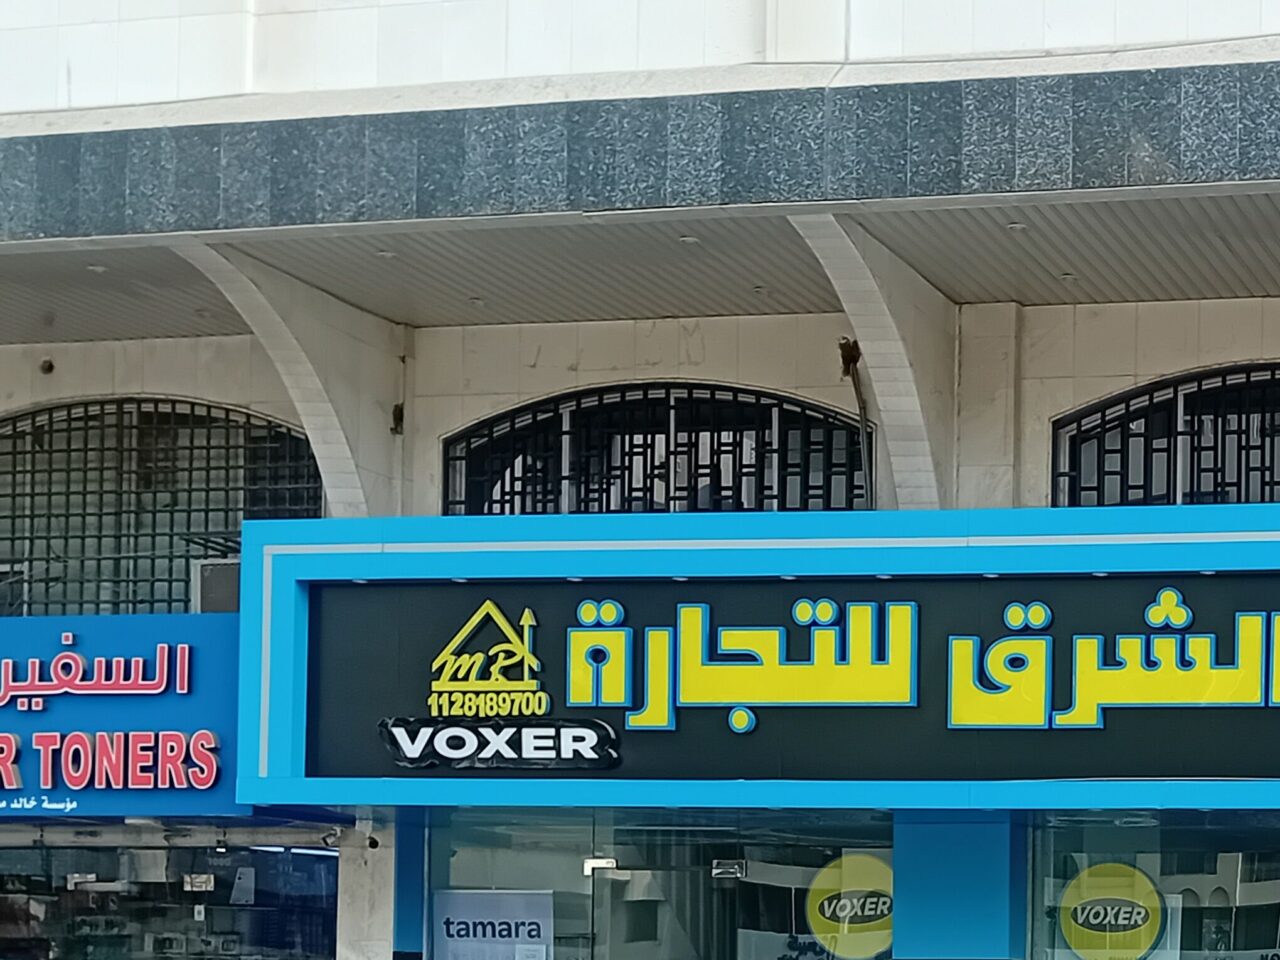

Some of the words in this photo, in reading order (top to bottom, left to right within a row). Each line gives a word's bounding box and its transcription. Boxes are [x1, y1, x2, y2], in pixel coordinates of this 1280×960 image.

[0, 632, 191, 711] السفير
[566, 598, 918, 734] للتجارة
[428, 691, 549, 717] 1128189700
[390, 727, 600, 759] VOXER
[32, 729, 219, 790] TONERS
[822, 894, 892, 918] VOXER
[1075, 905, 1146, 926] VOXER
[443, 917, 541, 939] tamara
